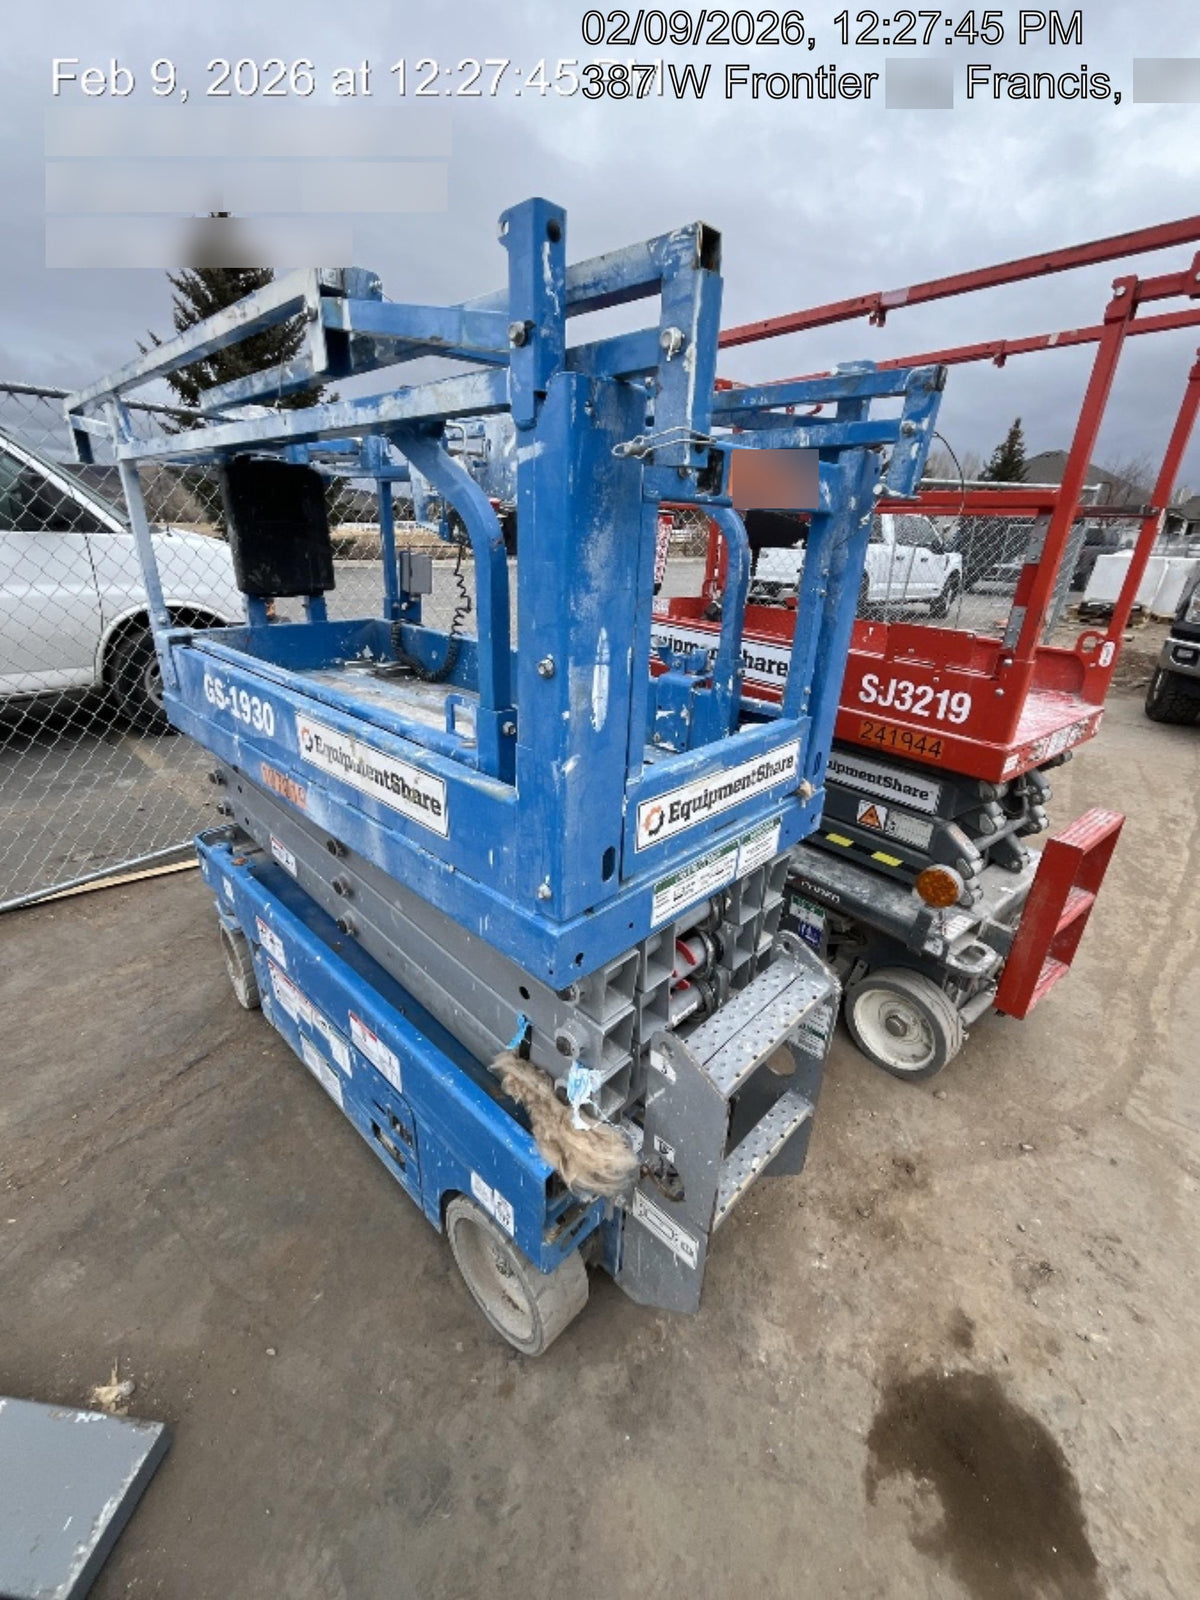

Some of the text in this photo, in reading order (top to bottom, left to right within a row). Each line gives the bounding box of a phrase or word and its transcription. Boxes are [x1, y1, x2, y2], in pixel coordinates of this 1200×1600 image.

[203, 672, 275, 737] GS-1930
[858, 673, 972, 724] SJ3219
[860, 722, 942, 758] 241944
[314, 734, 442, 817] EquipmentShare
[668, 755, 794, 824] EquipmentShare
